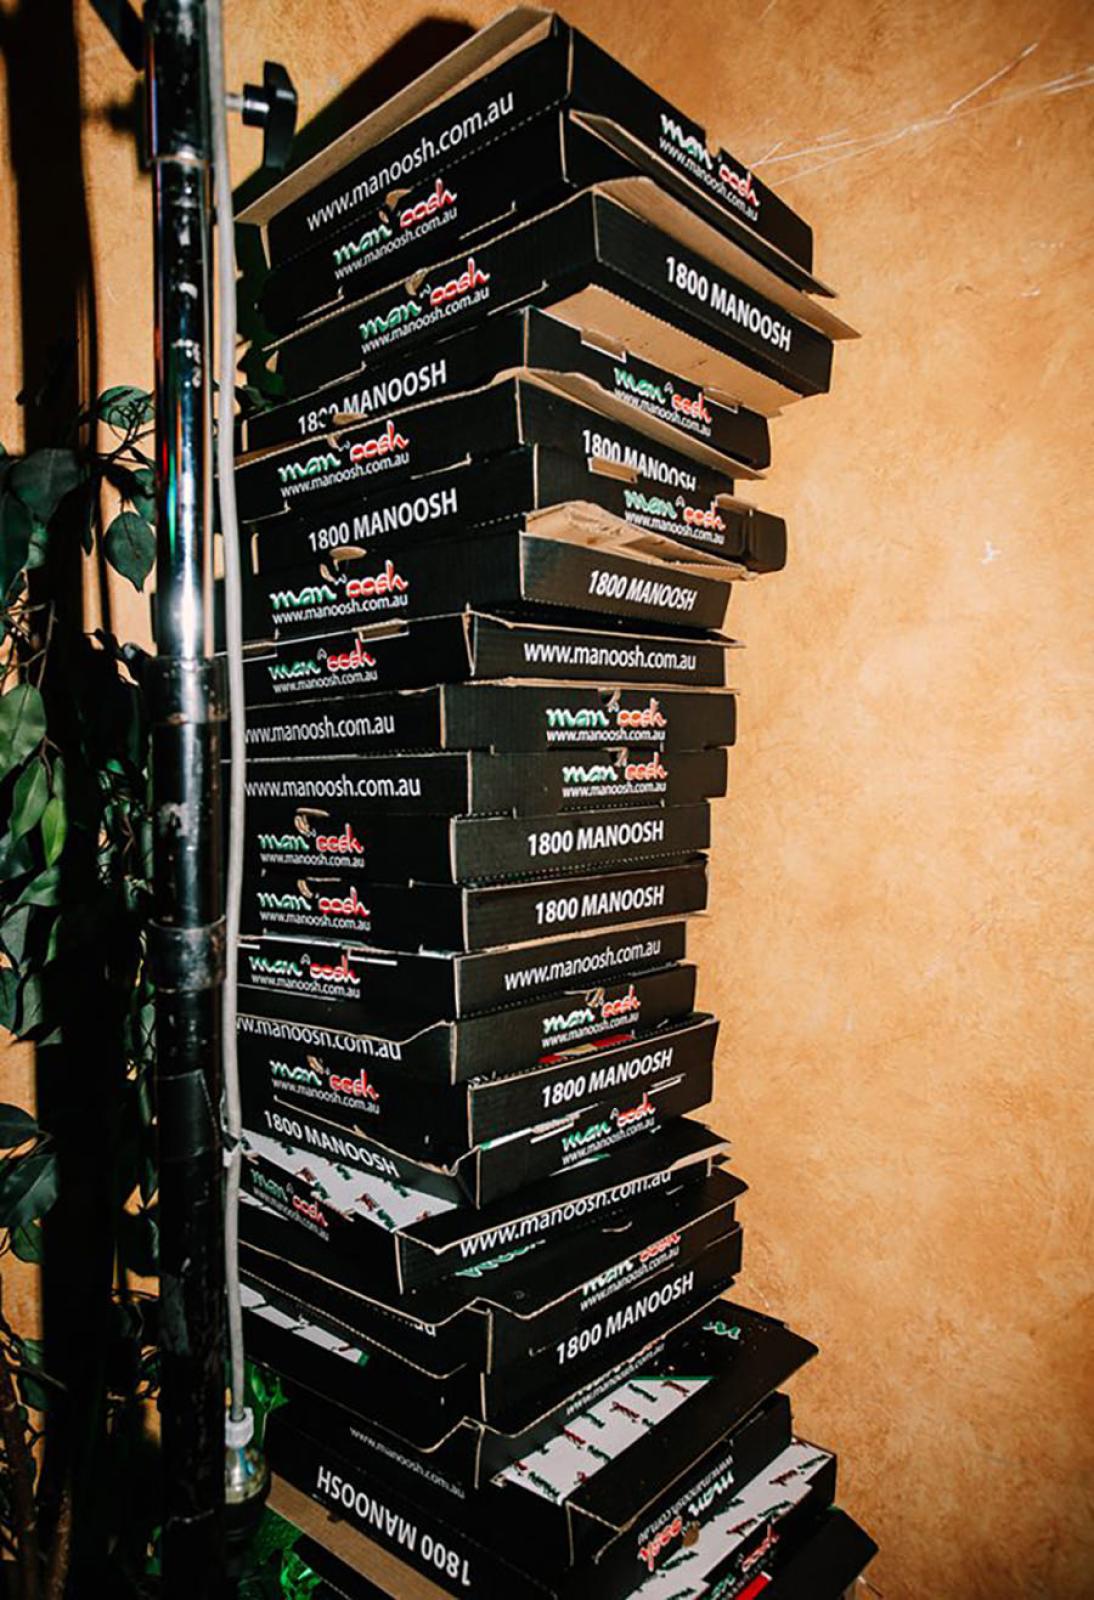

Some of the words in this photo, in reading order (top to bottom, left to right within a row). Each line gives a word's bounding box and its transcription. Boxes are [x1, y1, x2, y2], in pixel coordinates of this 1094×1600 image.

[306, 91, 515, 232] www.manoosh.com.au
[334, 207, 457, 280] www.manoosh.com.au
[361, 286, 490, 354] www.manoosh.com.au
[665, 256, 708, 301] 1800
[710, 282, 792, 352] MANOOSH
[343, 359, 447, 414] MANOOSH
[280, 451, 410, 498] www.manoosh.com.au
[624, 446, 696, 492] MANOOSH
[308, 521, 350, 553] 1800
[352, 487, 458, 541] MANOOSH
[272, 594, 408, 625] www.manoosh.com.au
[588, 570, 628, 599] 1800
[625, 579, 698, 612] MANOOSH
[523, 642, 697, 671] www.manoosh.com.au
[272, 670, 378, 694] www.manoosh.com.au
[546, 728, 666, 742] www.manoosh.com.au
[562, 781, 666, 798] www.manoosh.com.au
[259, 850, 365, 869] www.manoosh.com.au
[527, 830, 573, 857] 1800
[576, 819, 664, 851] MANOOSH
[259, 910, 371, 931] www.manoosh.com.au
[535, 897, 579, 925] 1800
[581, 885, 665, 918] MANOOSH
[251, 973, 361, 999] www.manoosh.com.au
[504, 939, 661, 991] www.manoosh.com.au
[271, 1077, 380, 1115] www.manoosh.com.au
[542, 1081, 585, 1108] 1800
[588, 1047, 673, 1094] MANOOSH
[264, 1110, 303, 1139] 1800
[304, 1125, 400, 1178] MANOOSH
[556, 1322, 602, 1365] 1800
[604, 1271, 694, 1339] MANOOSH
[316, 1465, 418, 1551] MANOOSH
[420, 1534, 471, 1586] 1800
